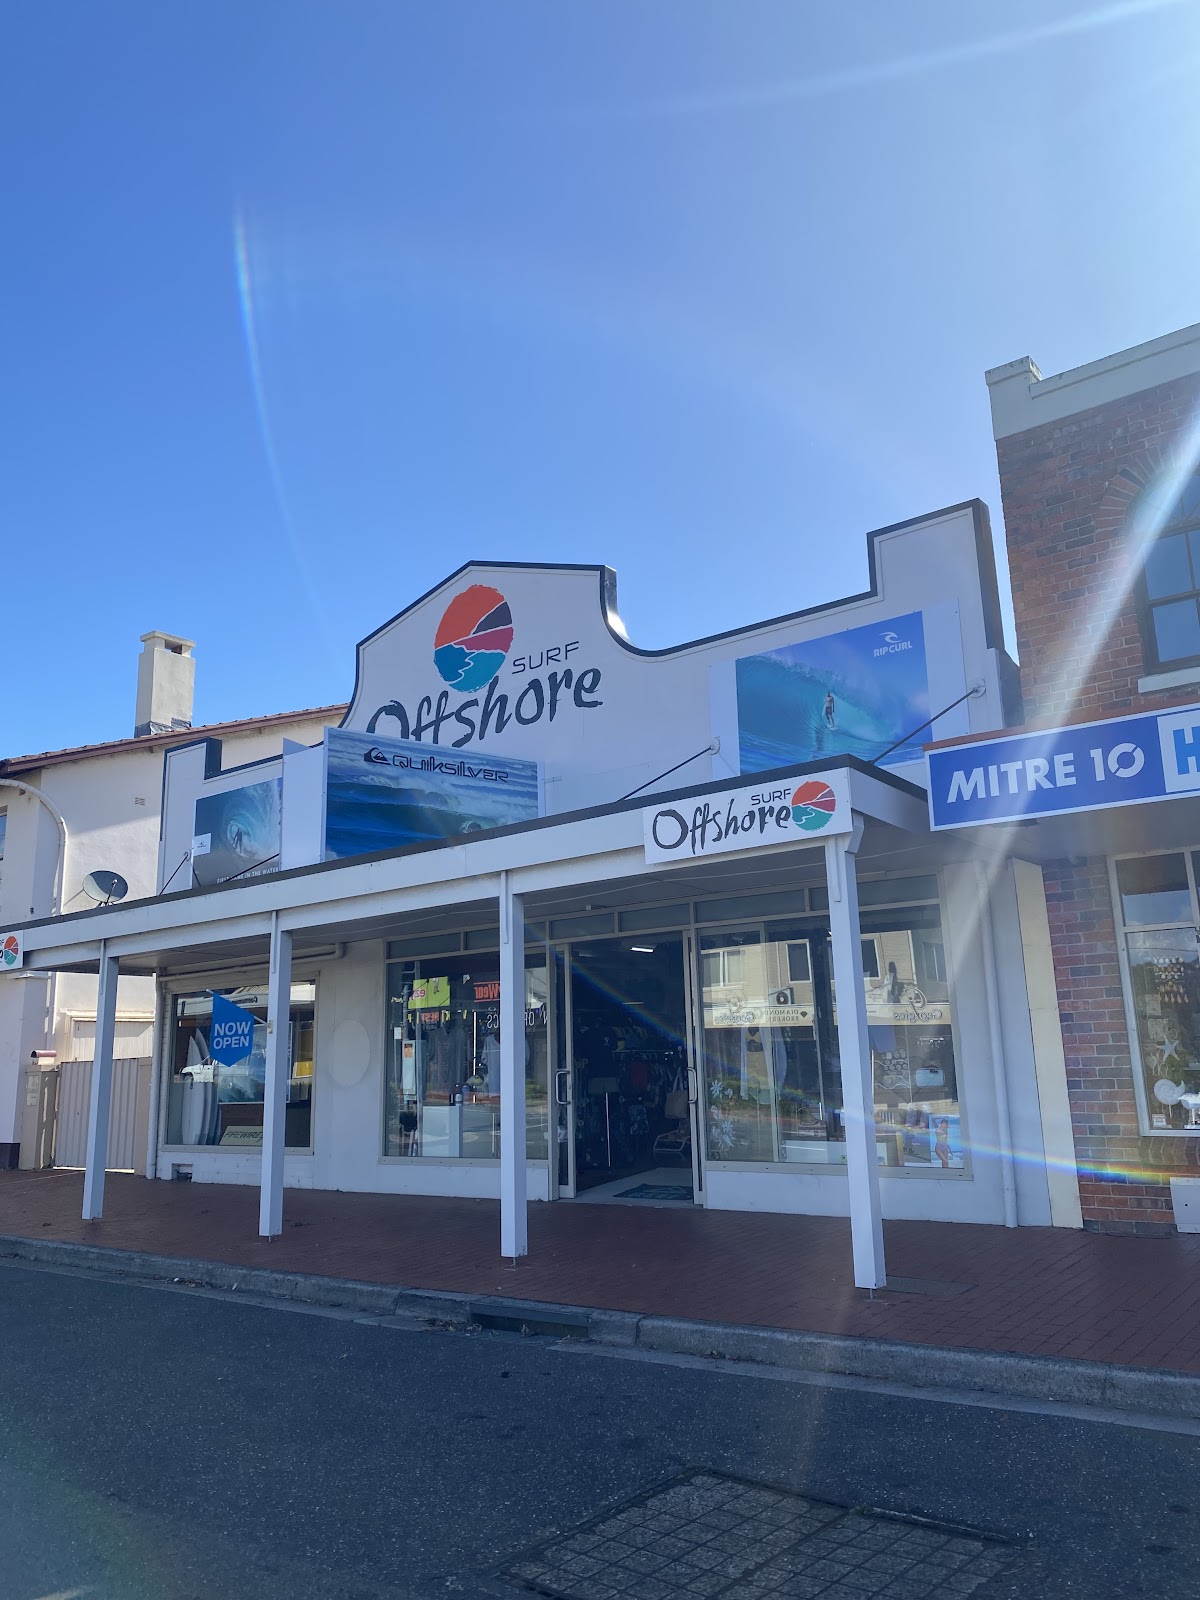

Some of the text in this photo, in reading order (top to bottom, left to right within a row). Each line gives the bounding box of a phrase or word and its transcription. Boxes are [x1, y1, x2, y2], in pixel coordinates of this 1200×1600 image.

[512, 641, 579, 674] SURF
[366, 667, 603, 748] Offshore
[947, 742, 1145, 803] MITRE 10
[750, 788, 792, 806] SURF
[652, 798, 792, 855] Offshore
[213, 1036, 250, 1049] OPEN
[214, 1021, 251, 1037] NOW
